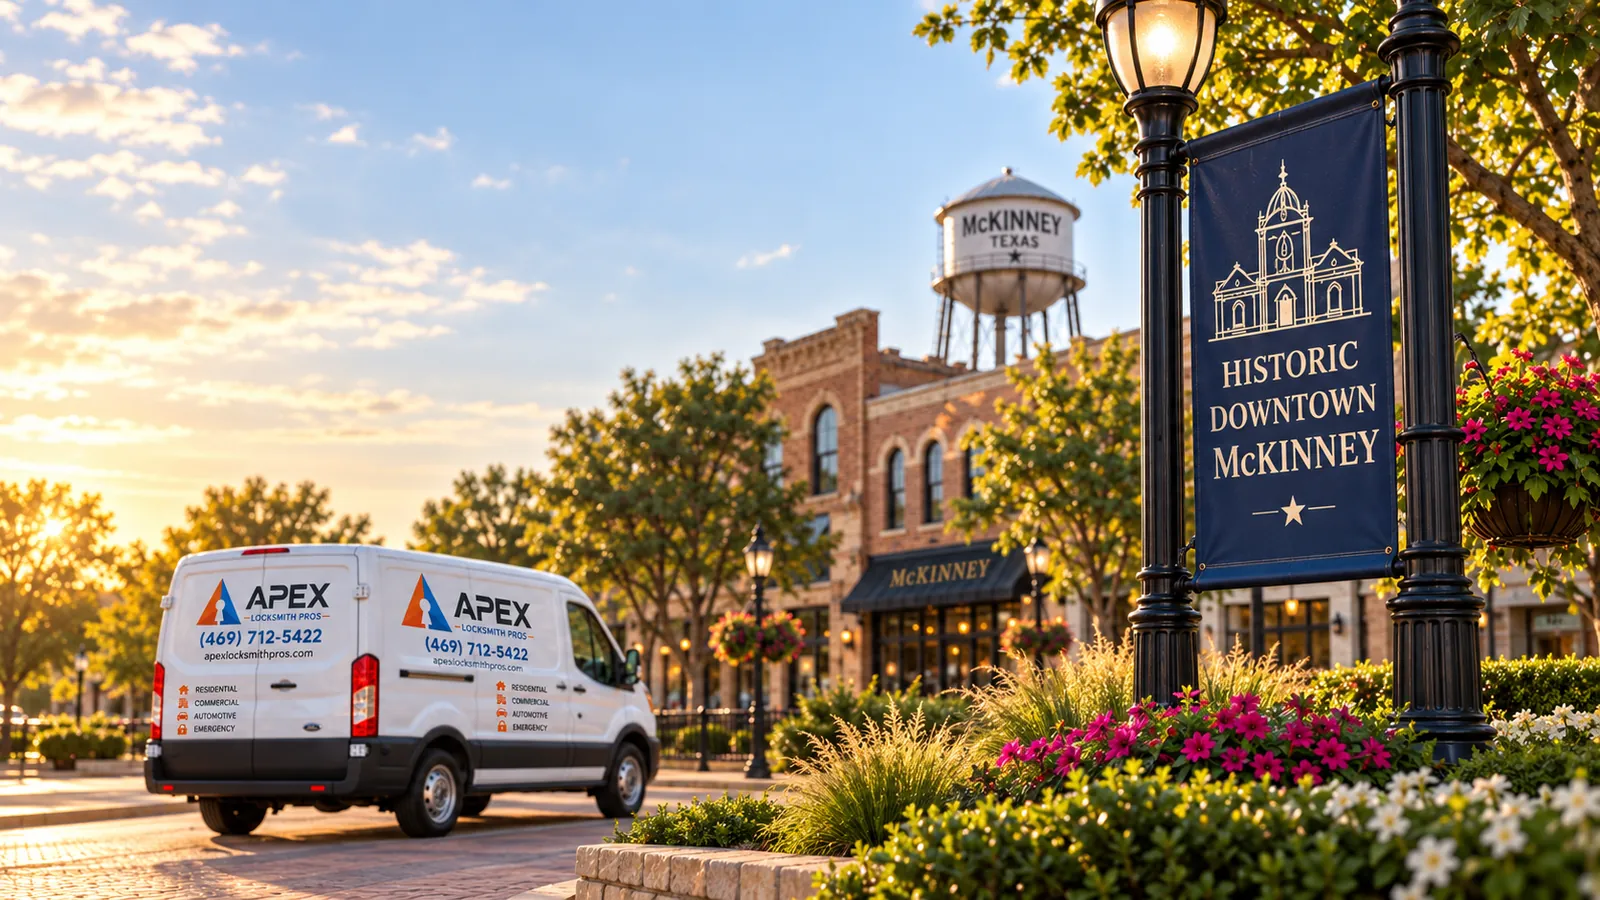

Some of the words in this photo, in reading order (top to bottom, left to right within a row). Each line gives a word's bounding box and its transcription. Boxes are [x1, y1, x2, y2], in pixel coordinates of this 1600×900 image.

[962, 209, 1061, 237] McKINNEY
[990, 234, 1039, 248] TEXAS
[1221, 340, 1359, 389] HISTORIC
[1209, 383, 1377, 433] DOWNTOWN
[1212, 428, 1380, 480] McKINNEY
[889, 559, 990, 588] McKINNEY
[245, 582, 331, 610] APEX
[250, 613, 297, 622] LOCKSMITH
[298, 612, 322, 621] PROS
[454, 591, 532, 629] APEX
[199, 630, 242, 649] (469)
[247, 628, 323, 645] 712-5422
[461, 623, 506, 637] LOCKSMITH
[507, 630, 528, 641] PROS
[204, 649, 313, 661] apexlocksmithpros.com
[425, 635, 462, 657] (469)
[467, 641, 529, 662] 712-5422
[195, 685, 238, 694] RESIDENTIAL
[194, 699, 239, 707] COMMERCIAL
[193, 712, 237, 720] AUTOMOTIVE
[512, 710, 548, 719] AUTOMOTIVE
[193, 725, 236, 733] EMERGENCY
[512, 723, 548, 732] EMERGENCY
